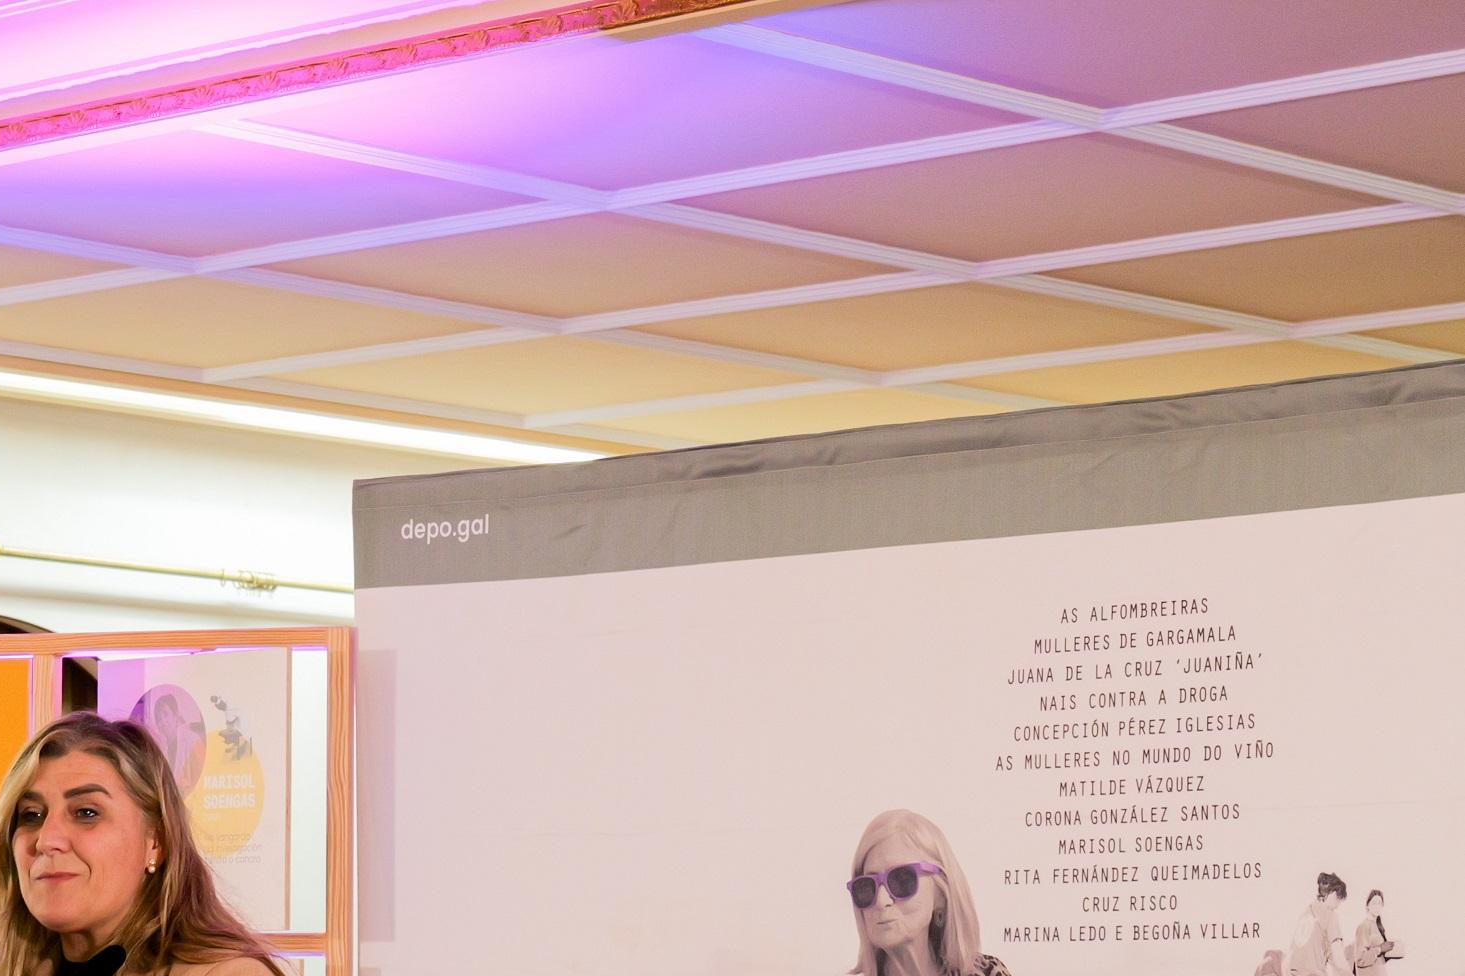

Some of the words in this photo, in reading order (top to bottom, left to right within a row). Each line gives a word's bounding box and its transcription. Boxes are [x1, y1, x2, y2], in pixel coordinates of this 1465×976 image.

[401, 514, 490, 544] depo.gal
[1061, 608, 1078, 624] AS
[1090, 598, 1209, 622] ALFOMBREIRAS
[1034, 634, 1111, 655] MULLERES
[1119, 632, 1137, 649] DE
[1146, 625, 1236, 648] GARGAMALA
[1007, 667, 1054, 685] JUANA
[1066, 665, 1083, 682] DE
[1095, 663, 1113, 680] LA
[1124, 660, 1163, 678] CRUZ
[1040, 695, 1077, 712] NAIS
[1089, 690, 1147, 710] CONTRA
[1158, 689, 1167, 705] A
[1179, 685, 1228, 704] DROGA
[1014, 719, 1109, 742] CONCEPCIÓN
[1118, 717, 1166, 737] PÉREZ
[1176, 713, 1256, 734] IGLESIAS
[996, 755, 1013, 772] AS
[1024, 751, 1101, 770] MULLERES
[1112, 750, 1130, 766] NO
[1142, 746, 1191, 765] MUNDO
[1204, 745, 1222, 762] DO
[1234, 740, 1274, 759] VIÑO
[204, 773, 255, 789] MARISOL
[1059, 779, 1127, 798] MATILDE
[1136, 775, 1205, 794] VÁZQUEZ
[203, 793, 256, 810] SOENGAS
[1025, 810, 1082, 828] CORONA
[1090, 805, 1168, 825] GONZÁLEZ
[1181, 803, 1240, 822] SANTOS
[1058, 838, 1126, 855] MARISOL
[1135, 834, 1203, 852] SOENGAS
[1004, 869, 1041, 885] RITA
[1053, 865, 1139, 885] FERNÁNDEZ
[1151, 862, 1262, 882] QUEIMADELOS
[1082, 896, 1120, 913] CRUZ
[1129, 894, 1178, 911] RISCO
[1004, 925, 1061, 943] MARINA
[1069, 925, 1107, 942] LEDO
[1115, 924, 1123, 941] E
[1133, 921, 1191, 941] BEGOÑA
[1200, 922, 1261, 940] VILLAR
